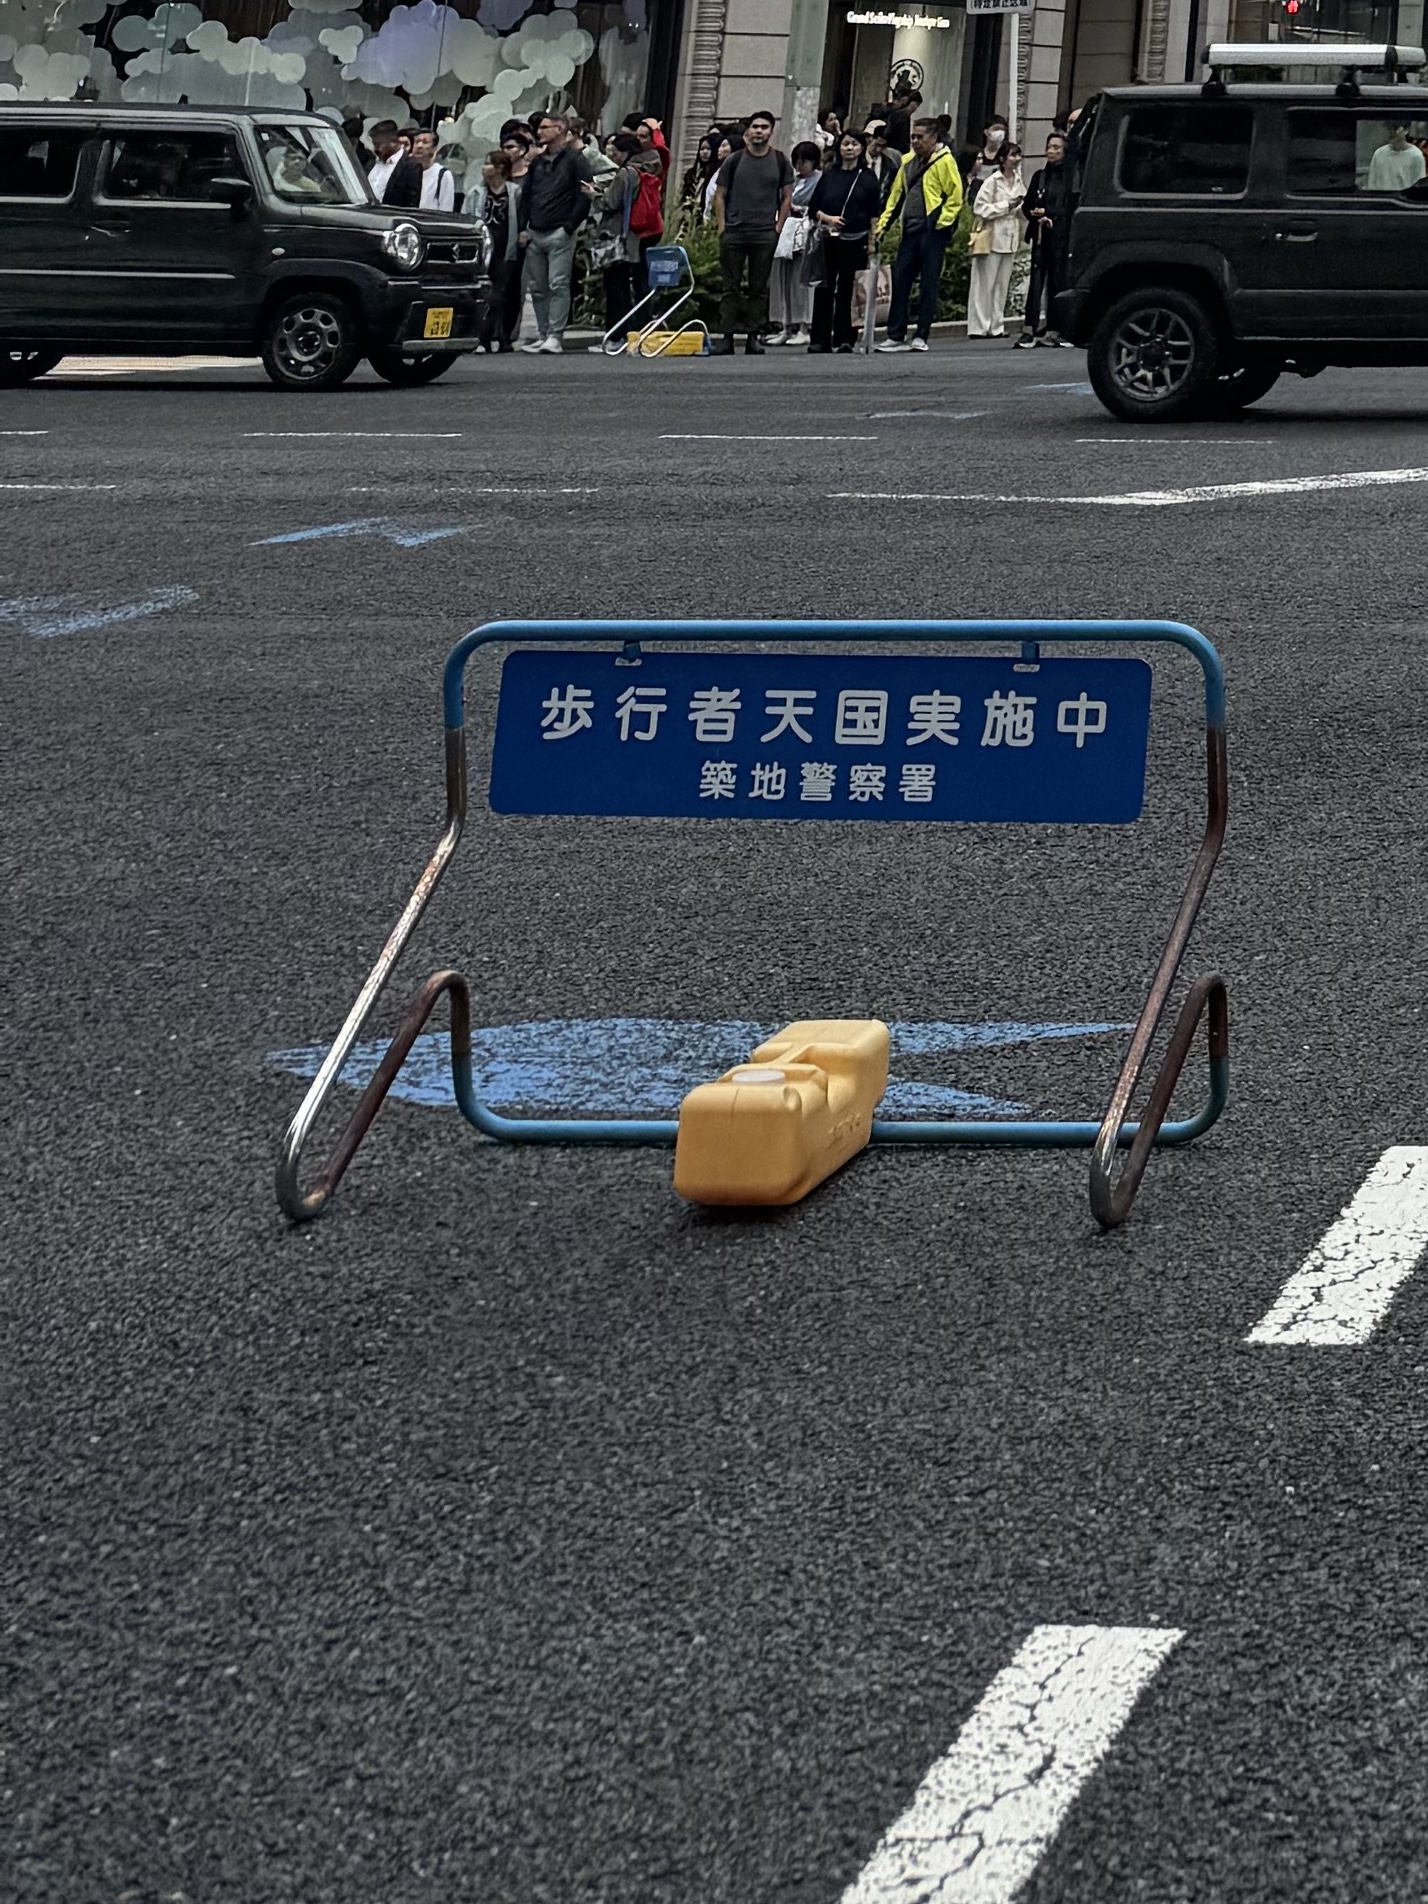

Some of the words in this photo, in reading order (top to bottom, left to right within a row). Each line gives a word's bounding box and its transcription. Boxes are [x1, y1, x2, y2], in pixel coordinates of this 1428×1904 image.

[540, 684, 1110, 749] 歩行者天国実施中
[699, 759, 939, 805] 築地警察署
